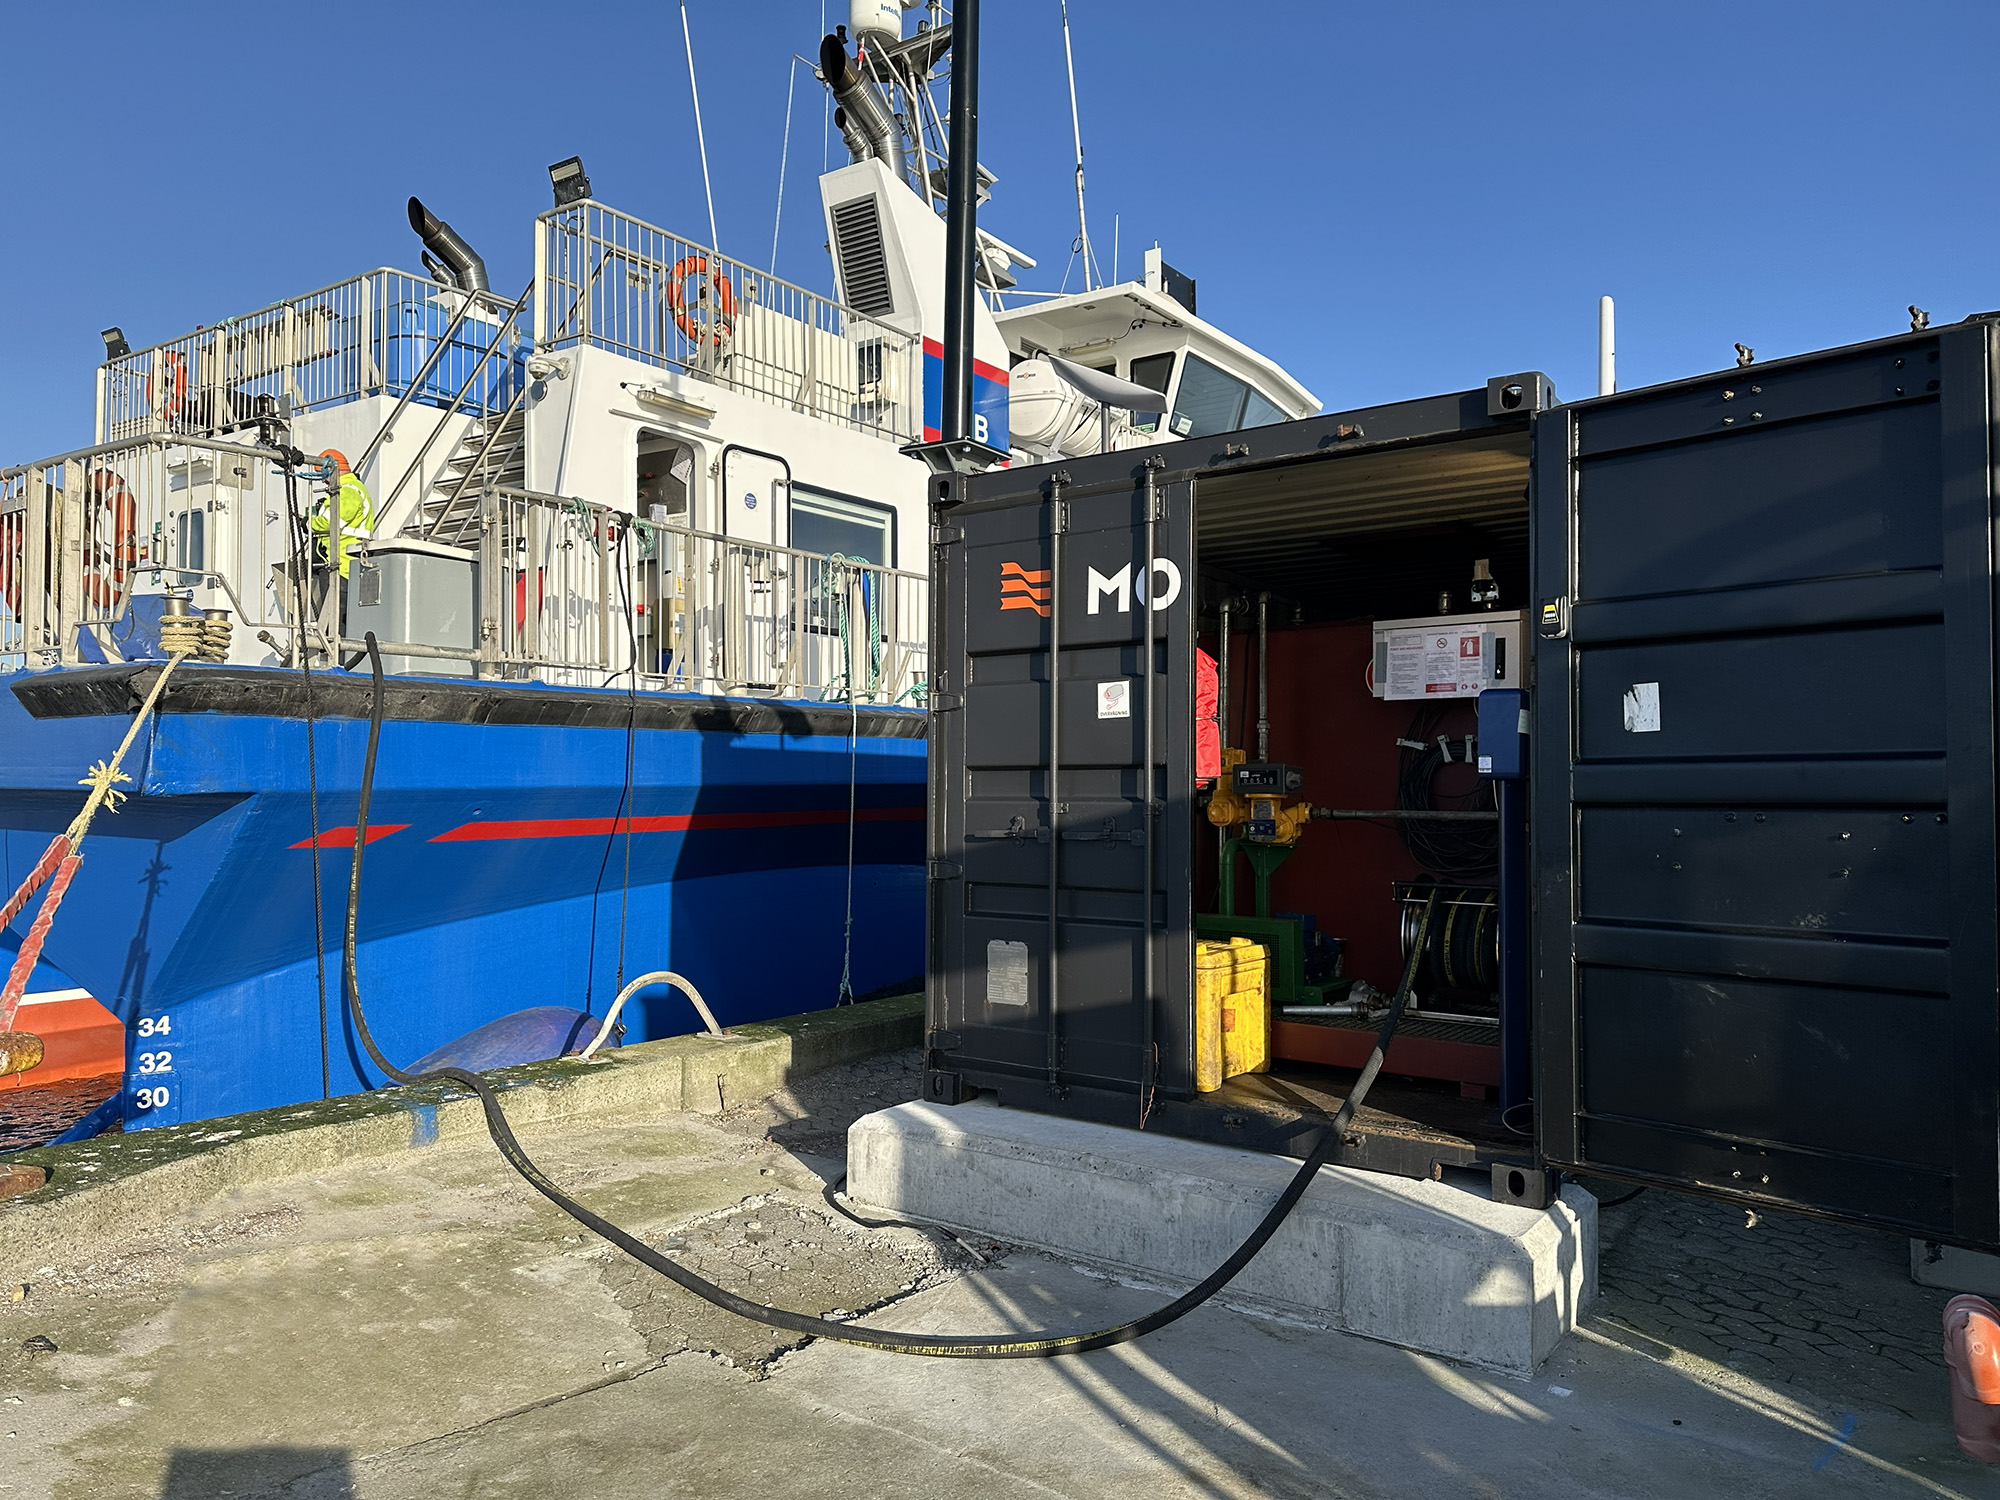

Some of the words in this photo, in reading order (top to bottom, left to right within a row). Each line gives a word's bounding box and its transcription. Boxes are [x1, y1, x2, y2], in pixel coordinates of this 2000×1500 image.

[974, 414, 989, 444] B
[1087, 557, 1182, 615] MO
[138, 1015, 171, 1037] 34
[139, 1051, 172, 1073] 32
[136, 1086, 169, 1109] 30
